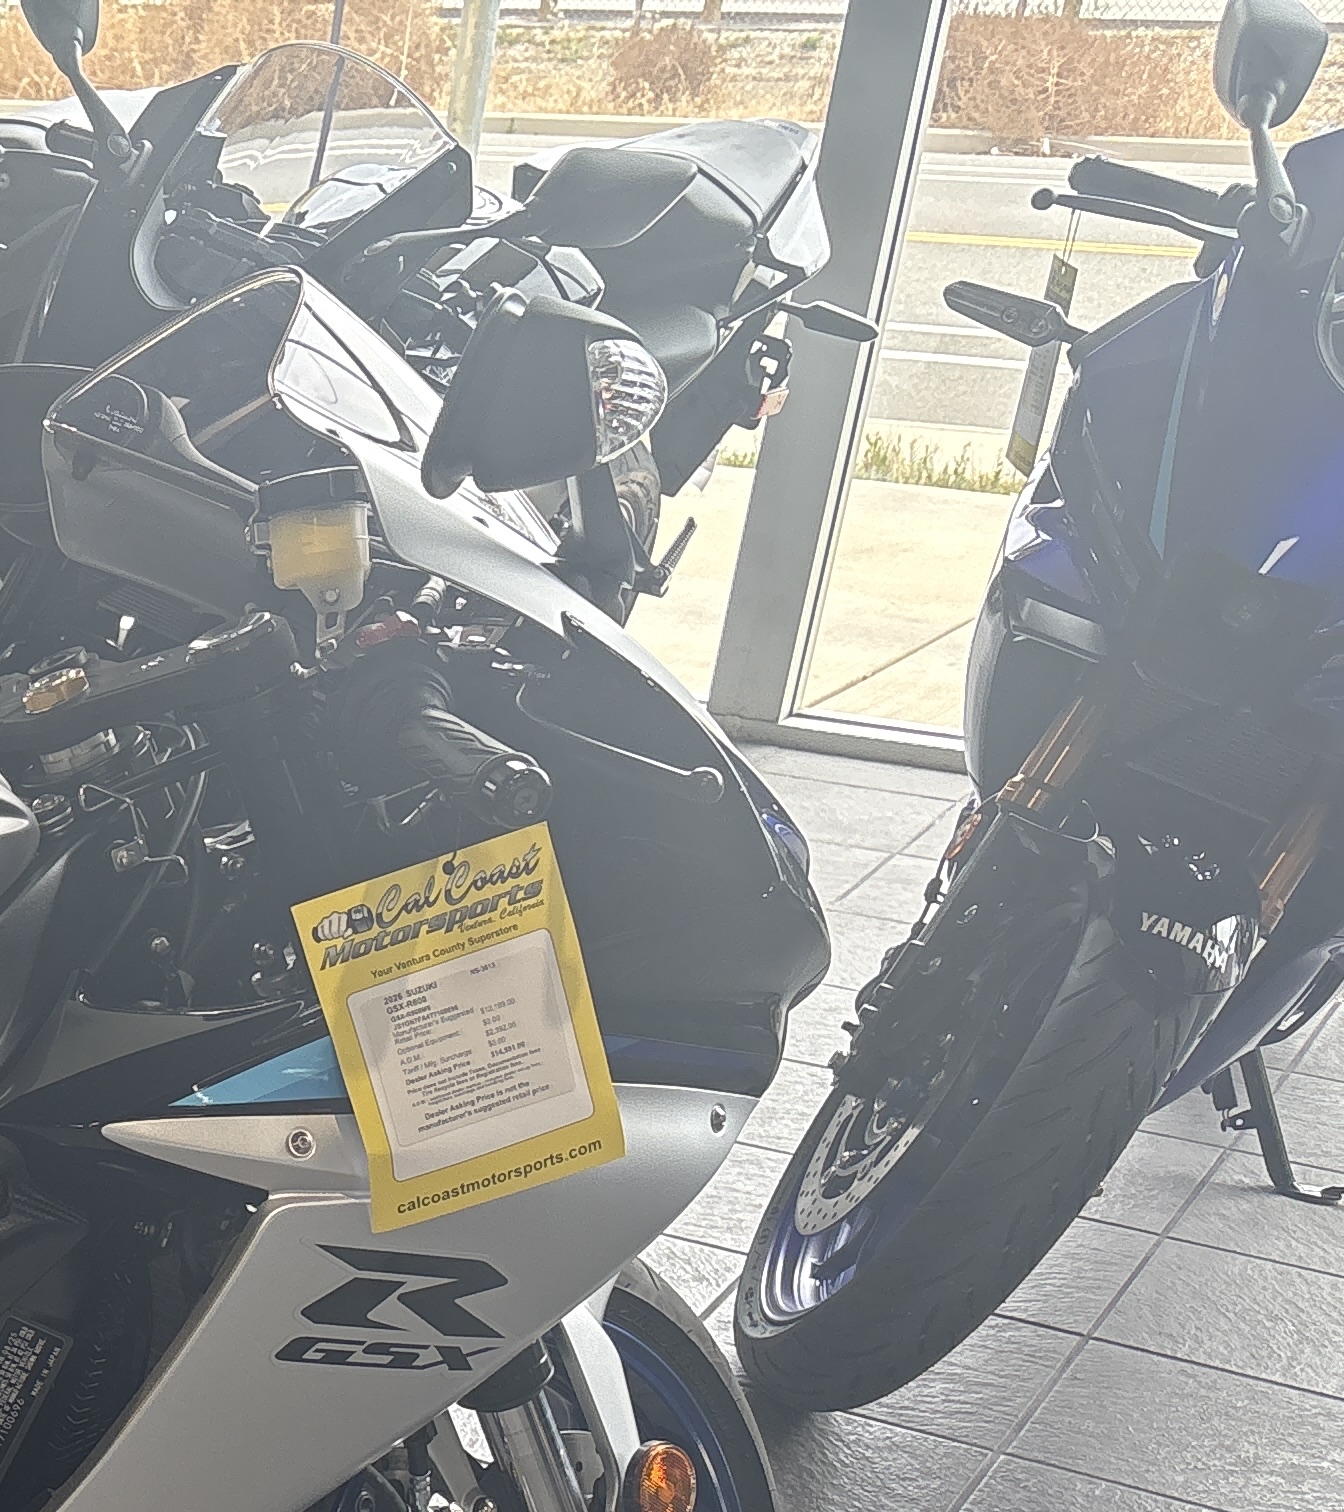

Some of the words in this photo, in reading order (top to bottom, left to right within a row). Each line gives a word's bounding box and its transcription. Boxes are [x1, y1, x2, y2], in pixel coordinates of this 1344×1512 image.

[376, 883, 442, 929] Cal
[444, 842, 543, 906] Coast
[499, 899, 544, 920] California
[319, 879, 544, 971] Motorsports
[1140, 911, 1229, 974] YAMAHA
[370, 967, 393, 979] Your
[394, 954, 431, 971] Ventura
[432, 942, 466, 958] County
[468, 923, 518, 947] Superstore
[406, 981, 438, 998] SUZUKI
[406, 1074, 427, 1086] Dealer
[429, 1066, 452, 1080] Asking
[453, 1060, 470, 1070] Price
[418, 1110, 472, 1133] manufacturer's
[473, 1098, 511, 1115] suggested
[512, 1090, 531, 1102] retail
[532, 1084, 550, 1096] price
[425, 1108, 448, 1120] Dealer
[450, 1099, 475, 1112] Asking
[477, 1092, 495, 1103] Price
[504, 1085, 517, 1093] not
[518, 1081, 529, 1089] the
[397, 1139, 602, 1214] calcoastmotorsports.com
[300, 1243, 509, 1339] R
[30, 1380, 43, 1397] MADE
[41, 1368, 50, 1377] IN
[47, 1347, 61, 1367] JAPAN
[275, 1336, 502, 1371] GSX
